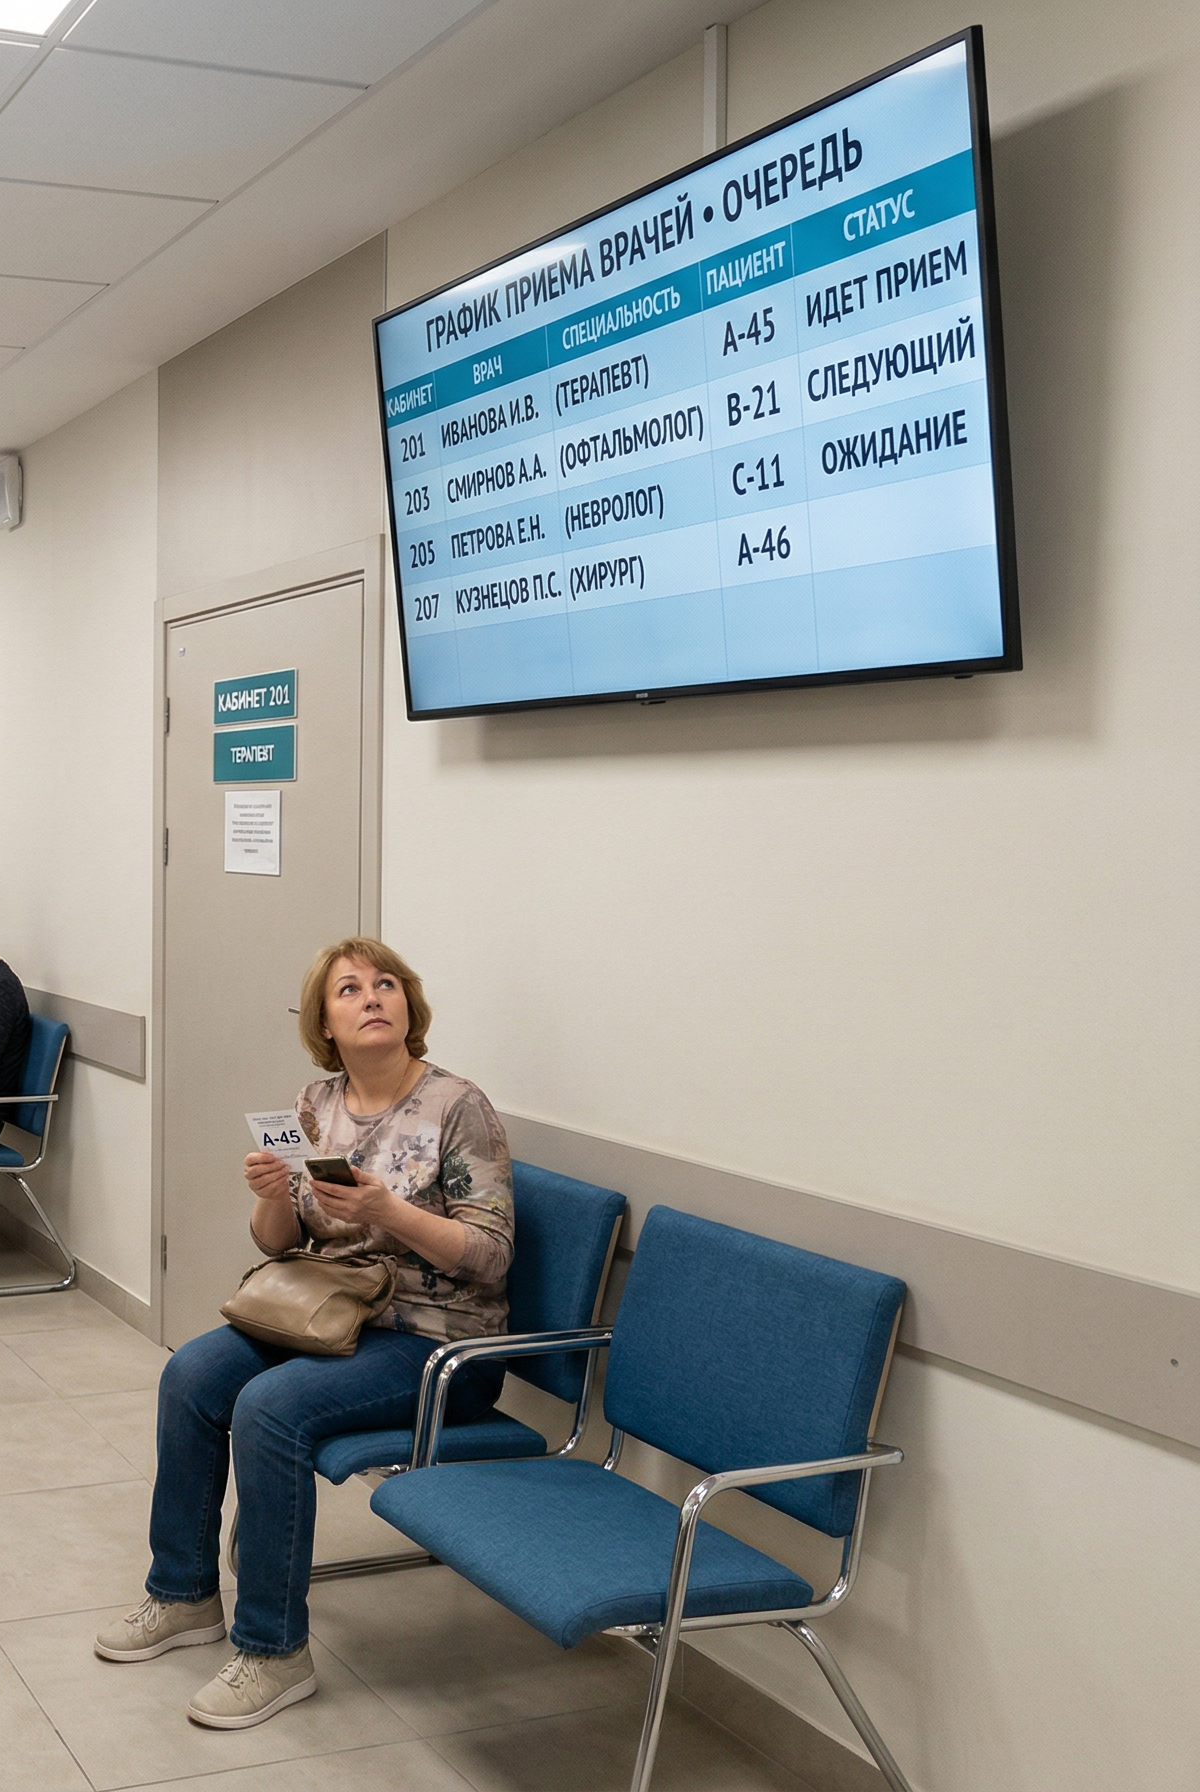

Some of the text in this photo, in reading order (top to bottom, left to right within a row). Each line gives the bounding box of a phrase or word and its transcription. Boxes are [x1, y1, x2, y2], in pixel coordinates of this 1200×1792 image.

[385, 188, 916, 418] КАБИНЕТ ВРАЧ СПЕЦИАЛЬНОСТЬ ПАЦИЕНТ СТАТУС
[425, 127, 863, 352] ГРАФИК ПРИЕМА ВРАЧЕЙ ОЧЕРЕДЬ
[400, 432, 426, 463] 201
[440, 403, 508, 449] ИВАНОВА
[509, 394, 540, 427] И.В.
[554, 353, 650, 417] (ТЕРАПЕВТ)
[805, 274, 868, 328] ИДЕТ
[875, 240, 968, 304] ПРИЕМ
[404, 486, 430, 516] 203
[446, 460, 515, 504] СМИРНОВ
[518, 453, 548, 485] А.А.
[559, 405, 704, 478] (ОФТАЛЬМОЛОГ)
[806, 315, 976, 402] СЛЕДУЮЩИЙ
[409, 540, 436, 569] 205
[450, 519, 515, 559] ПЕТРОВА
[517, 513, 546, 545] Е.Н.
[564, 483, 665, 540] (НЕВРОЛОГ)
[820, 409, 968, 475] ОЖИДАНИЕ
[414, 594, 440, 622] 207
[455, 576, 529, 614] КУЗНЕЦОВ
[532, 571, 563, 600] П.С.
[568, 554, 646, 602] (ХИРУРГ)
[218, 684, 290, 712] КАБИНЕТ 201
